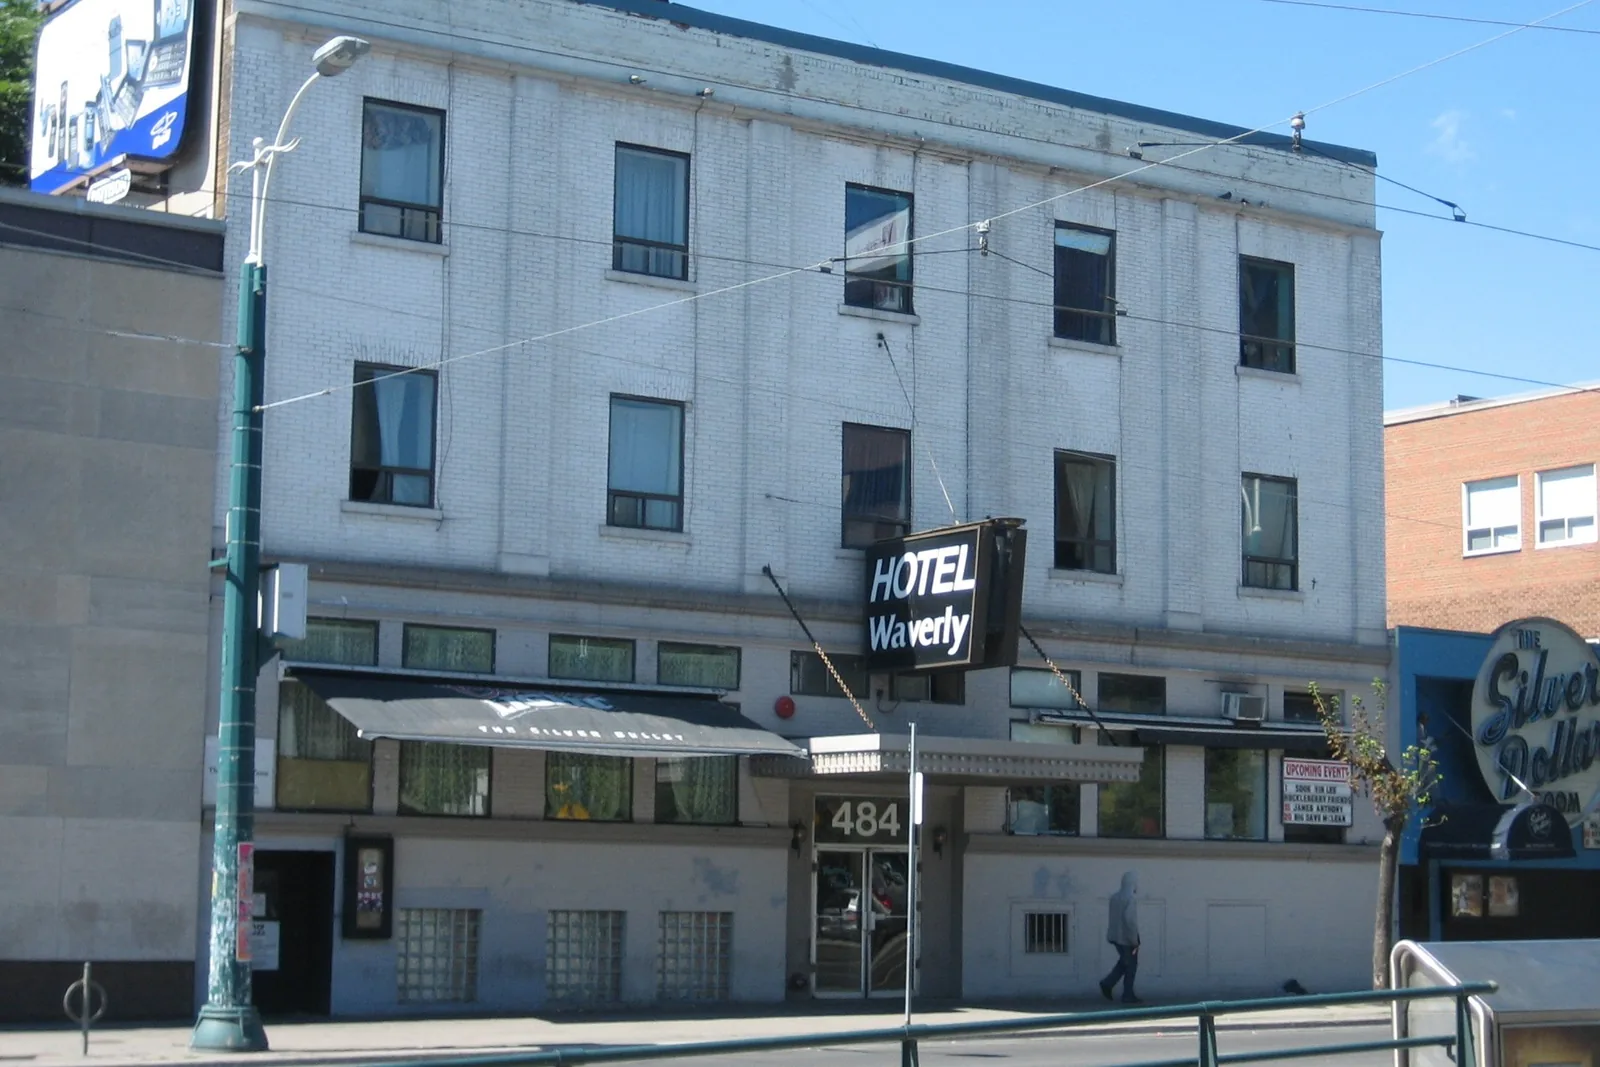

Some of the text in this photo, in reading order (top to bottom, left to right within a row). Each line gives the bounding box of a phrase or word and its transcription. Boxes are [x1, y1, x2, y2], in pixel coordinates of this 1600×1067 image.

[870, 543, 976, 603] HOTEL
[869, 605, 971, 656] Waverly
[1510, 627, 1542, 649] THE
[1478, 648, 1600, 746] Silver
[478, 725, 684, 741] THE SILVER BULLET
[1286, 763, 1349, 779] UPCOMING EVENTS
[831, 801, 901, 837] 484
[1293, 803, 1313, 812] JAMES
[1316, 804, 1343, 813] ANTHONY
